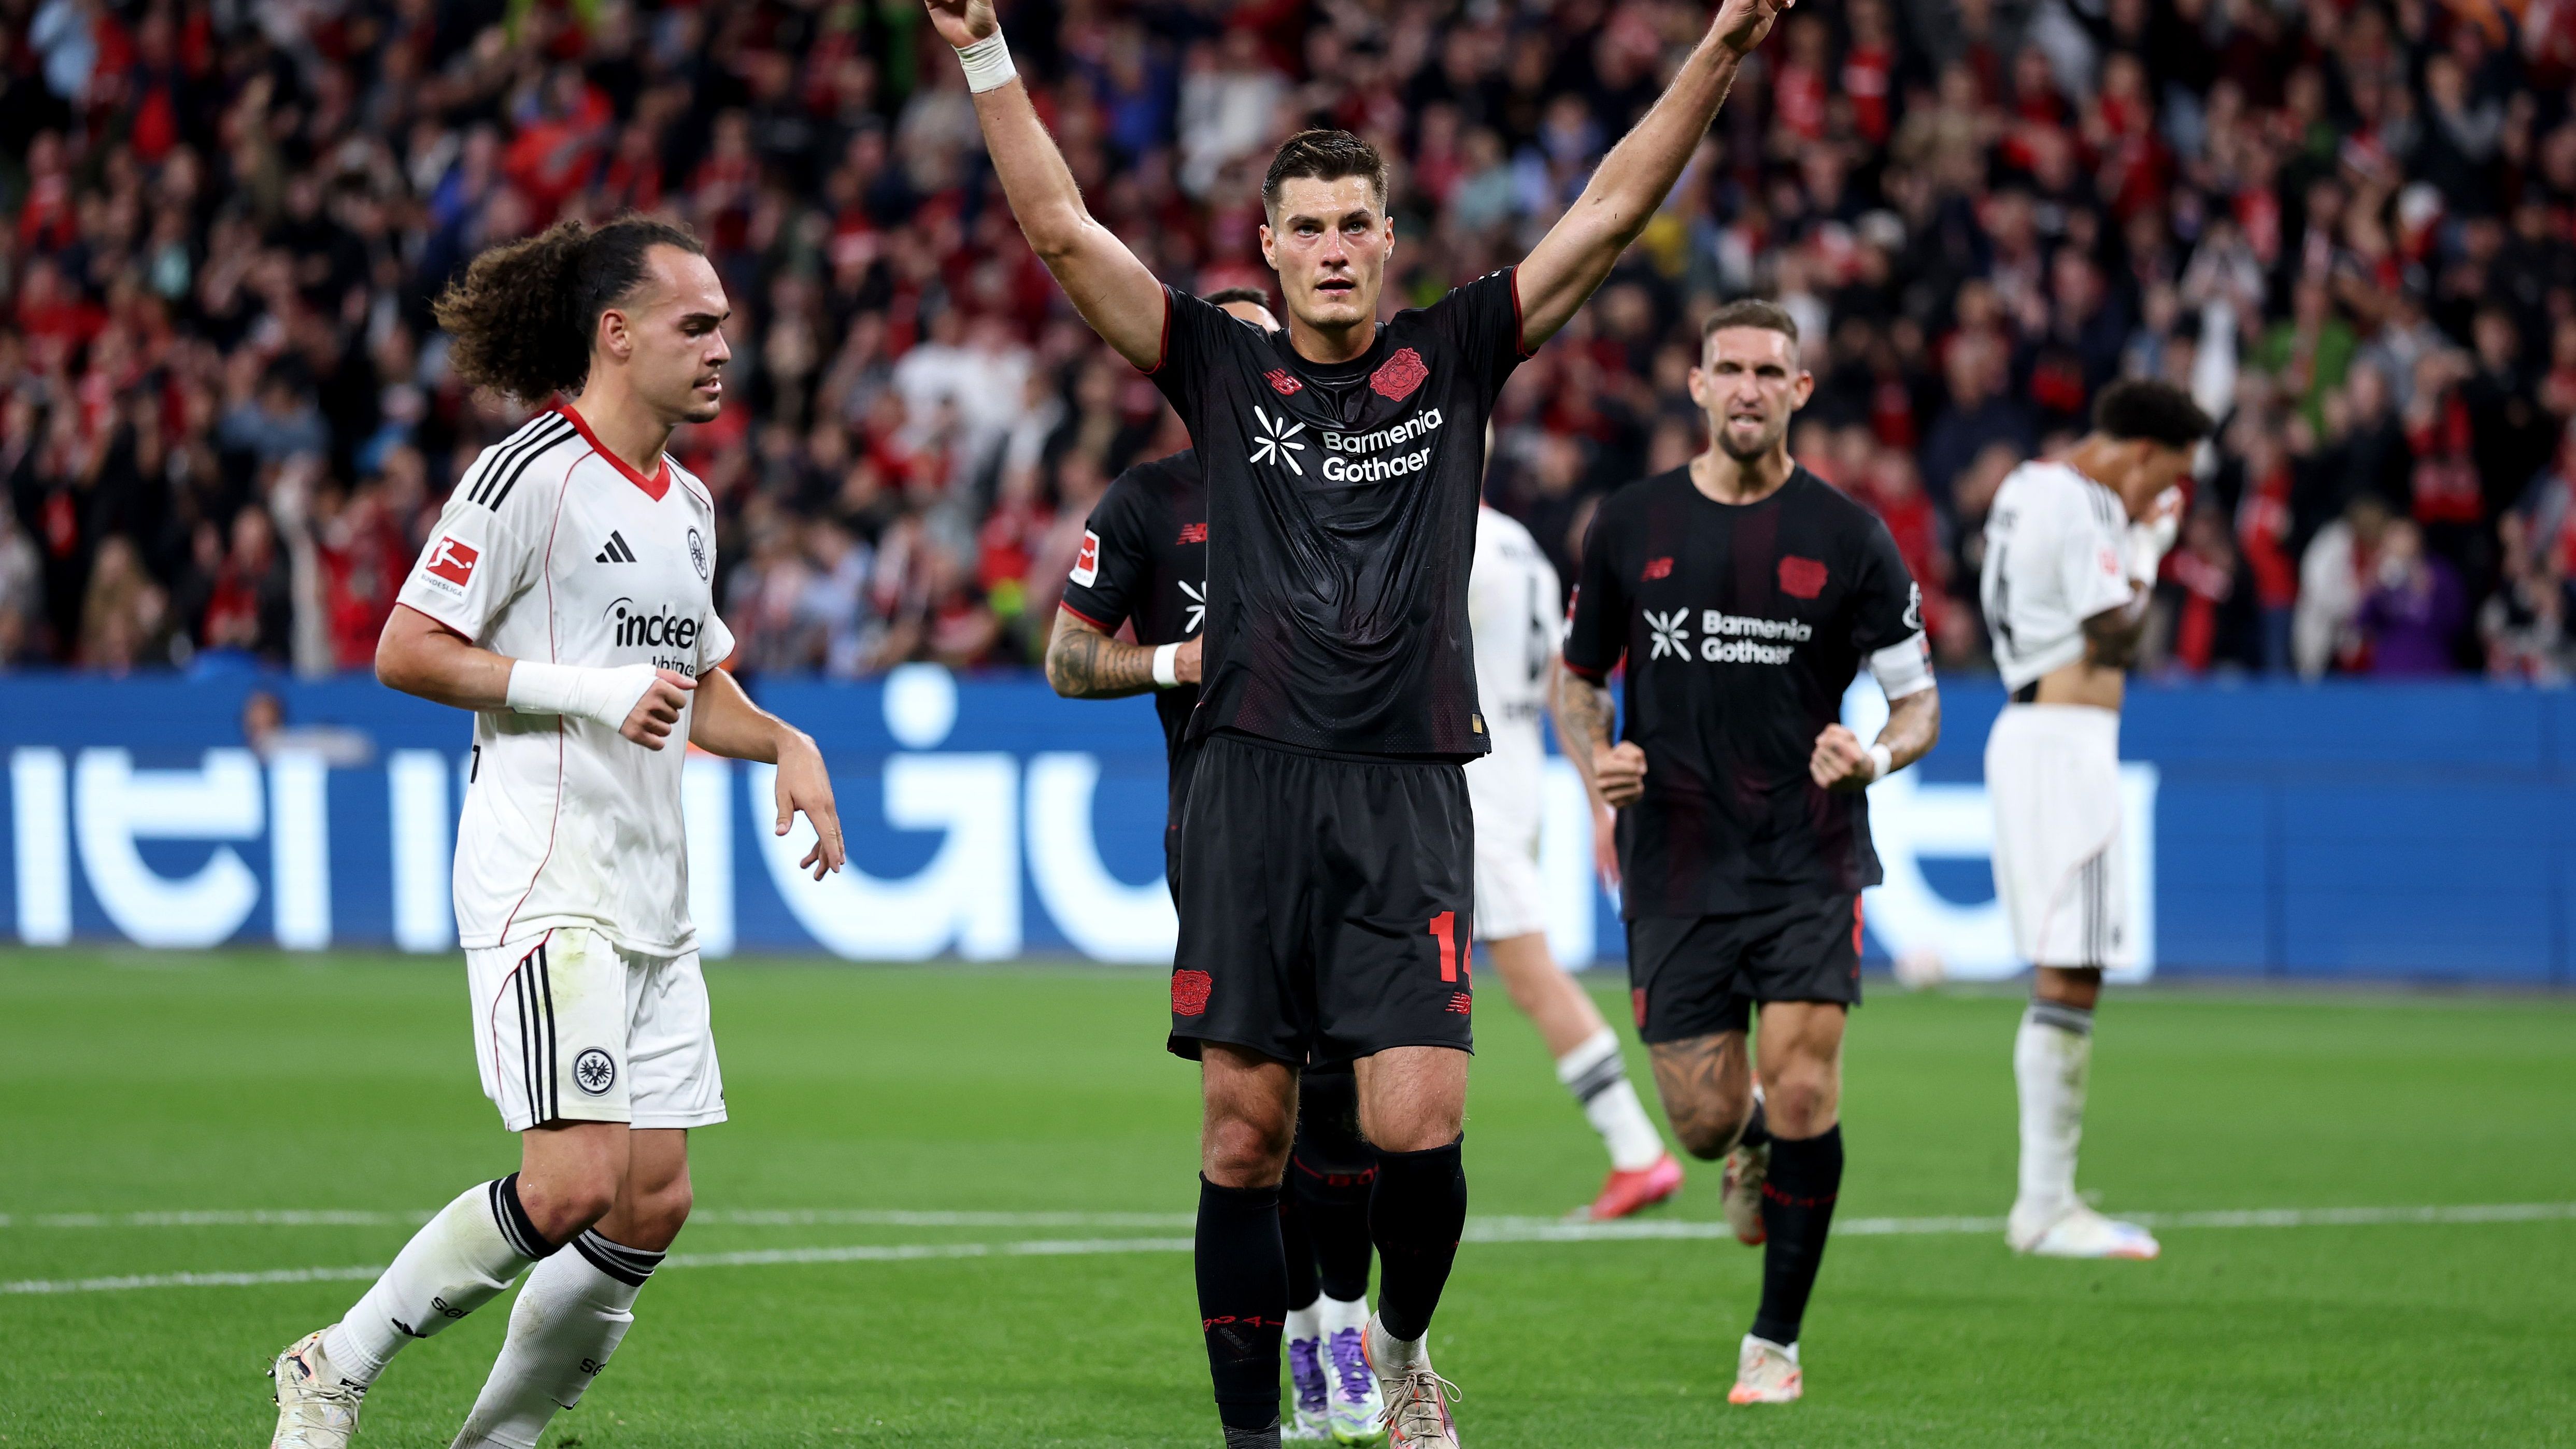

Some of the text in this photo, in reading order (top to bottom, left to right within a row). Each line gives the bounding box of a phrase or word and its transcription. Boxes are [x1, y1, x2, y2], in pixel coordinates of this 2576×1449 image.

[1322, 408, 1443, 454] Barmenia
[1322, 447, 1430, 482] Gothaer
[421, 573, 462, 597] BUNDESLIGA
[603, 597, 704, 651] indee
[1702, 609, 1813, 643] Barmenia
[1701, 637, 1795, 665] Gothaer
